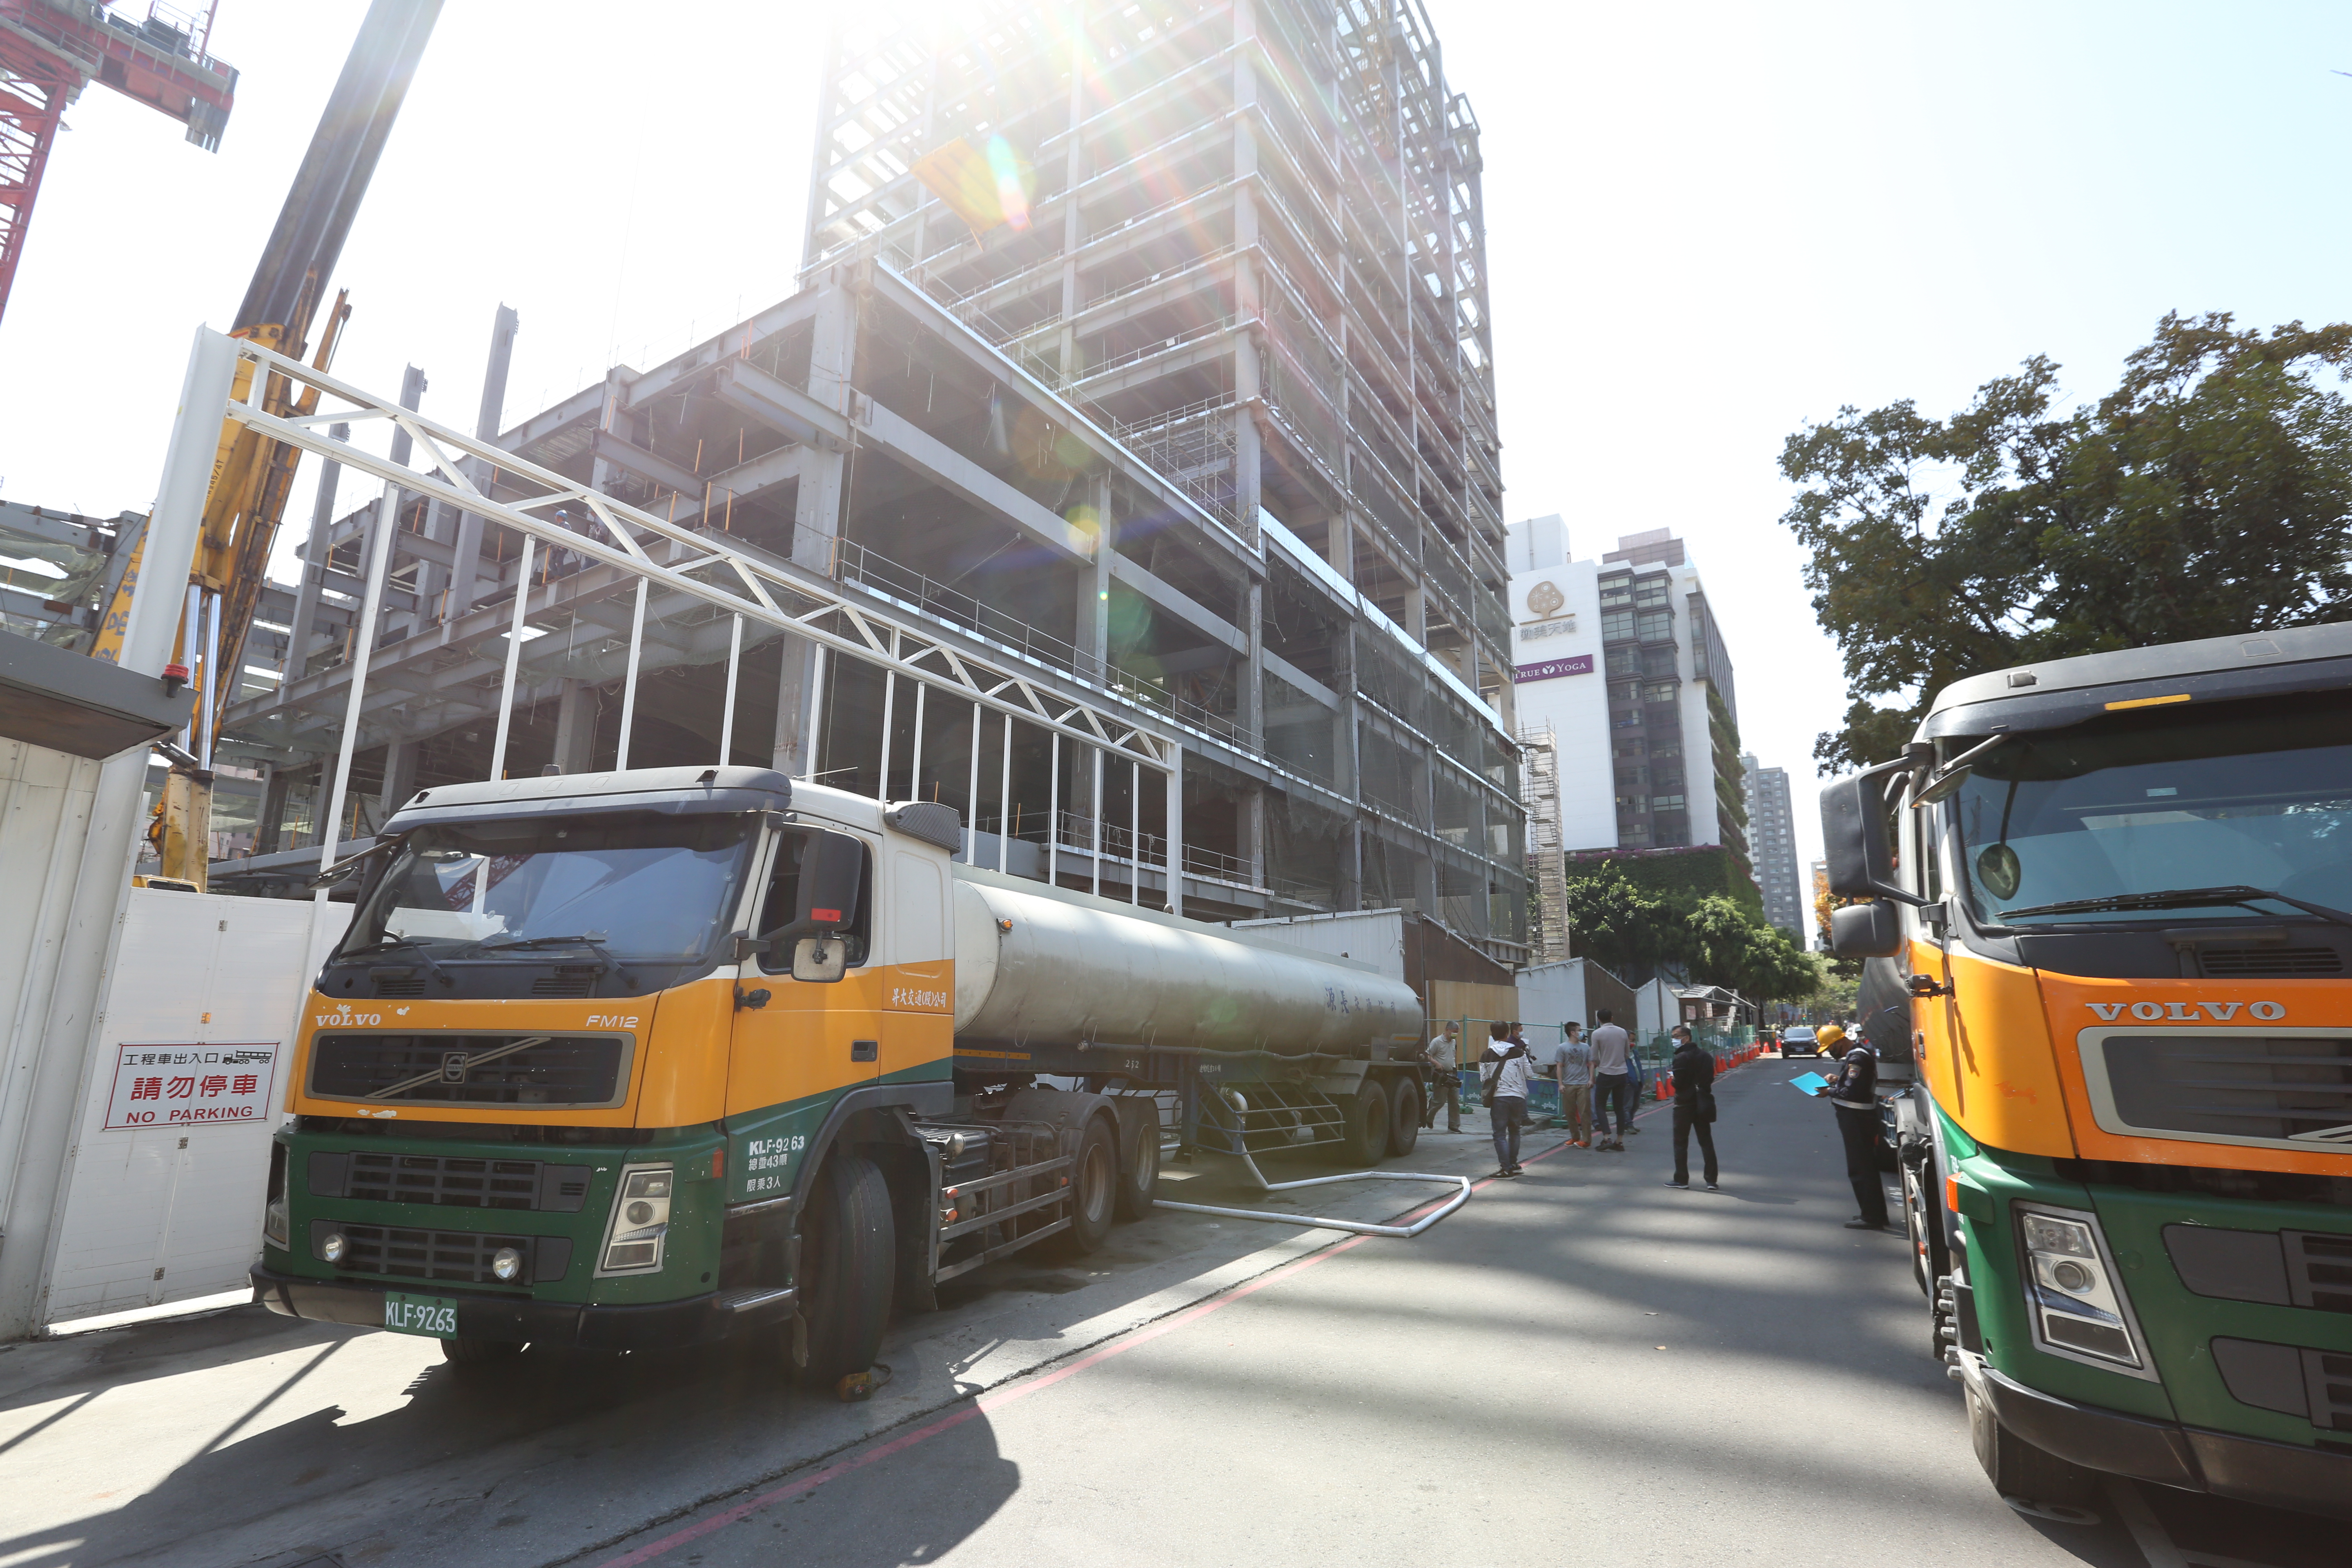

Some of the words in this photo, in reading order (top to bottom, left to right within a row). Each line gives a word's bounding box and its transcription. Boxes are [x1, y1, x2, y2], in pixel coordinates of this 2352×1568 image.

[1520, 619, 1576, 641] 勤美天地
[1556, 662, 1586, 673] YOGA
[2085, 1001, 2286, 1020] VOLVO
[316, 1014, 381, 1026] VOLVO
[586, 1015, 639, 1028] FM12
[123, 1052, 219, 1066] 工程車出入口
[130, 1074, 258, 1100] 請勿停車
[126, 1111, 155, 1124] NO
[169, 1106, 252, 1121] PARKING
[746, 1176, 781, 1193] 限乘3人
